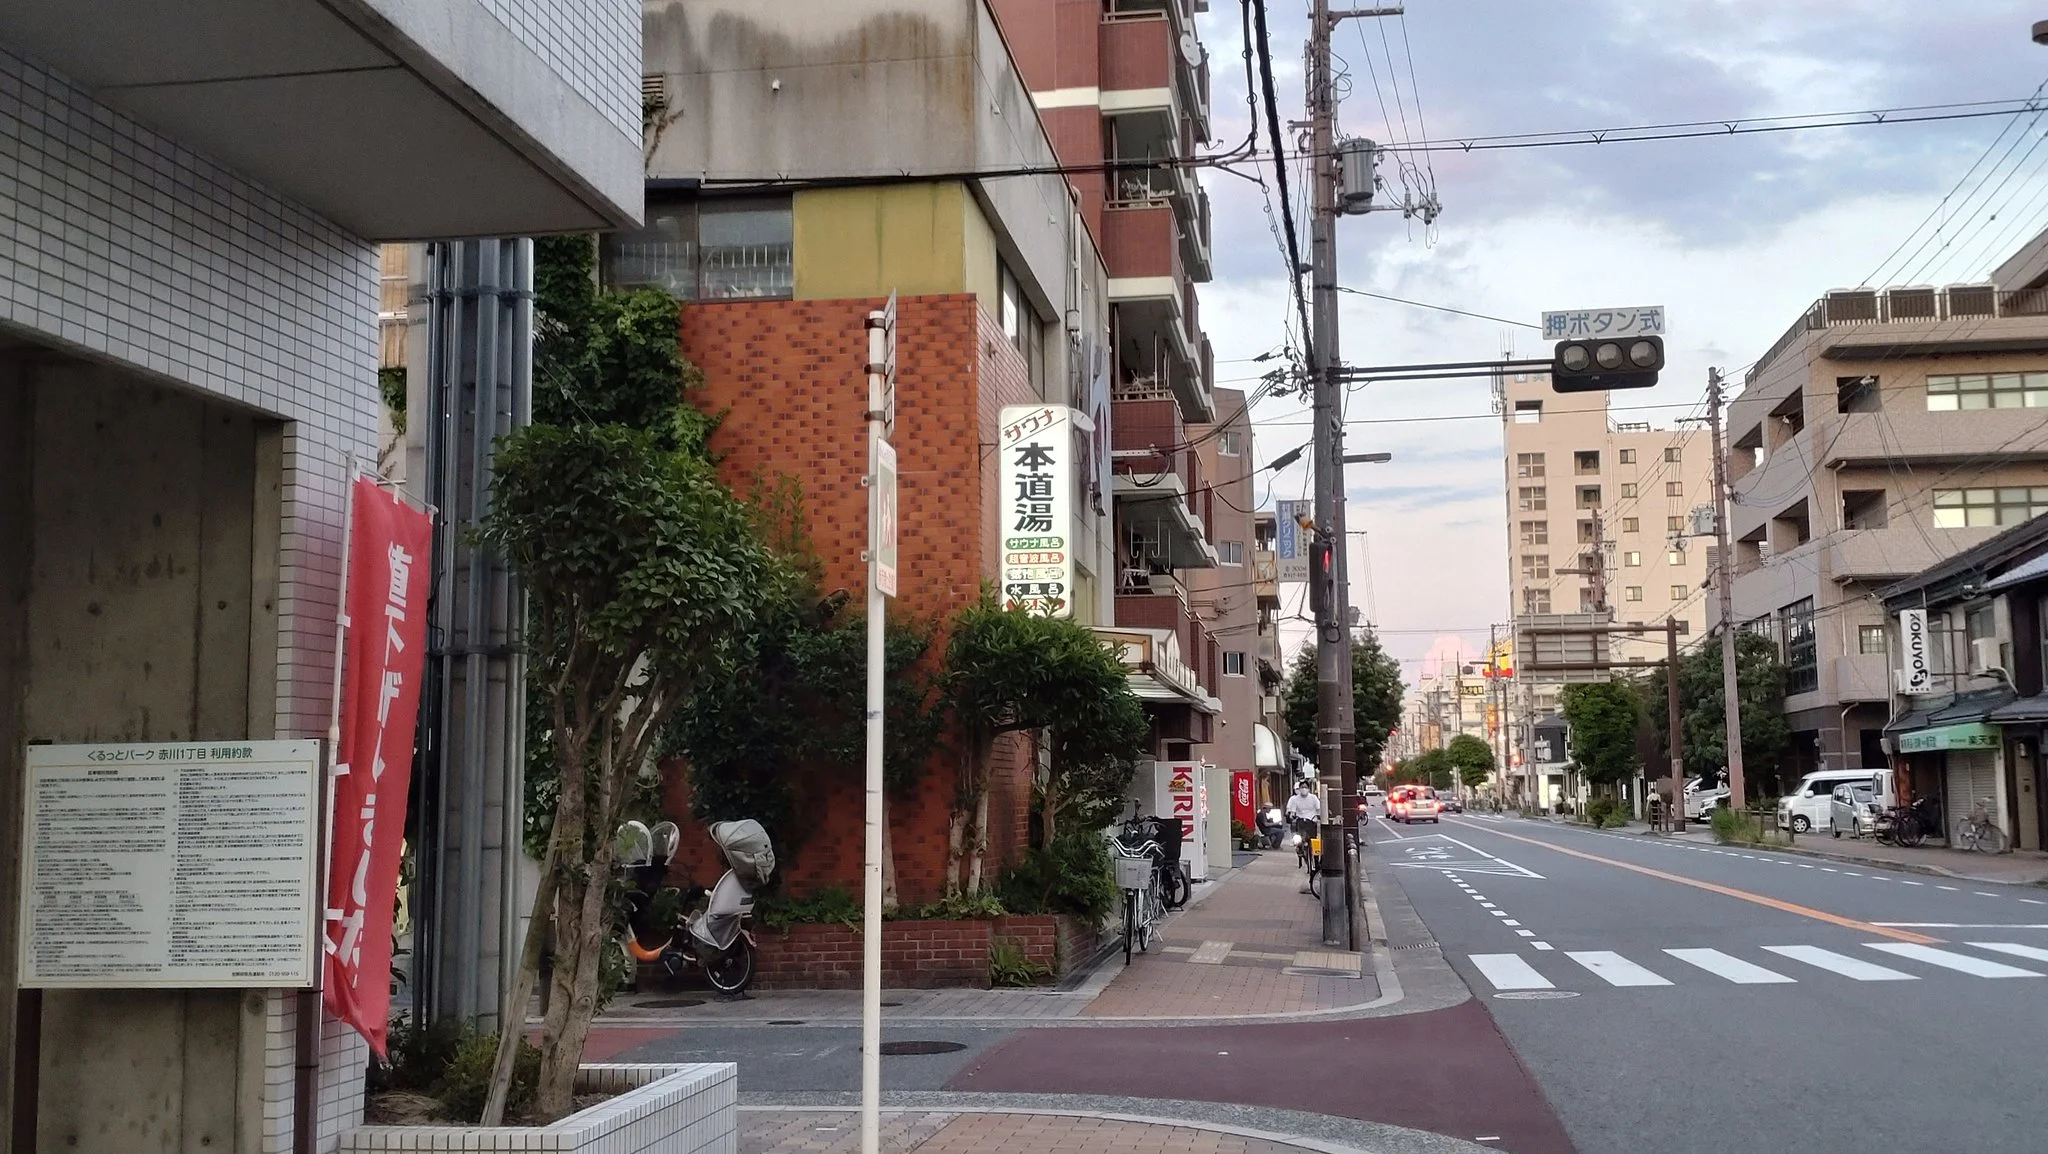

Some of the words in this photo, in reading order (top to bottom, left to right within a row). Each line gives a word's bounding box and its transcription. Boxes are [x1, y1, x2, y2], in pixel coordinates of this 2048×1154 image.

[1546, 309, 1661, 336] 押ボタン式
[1004, 409, 1054, 442] サウナ
[1014, 442, 1056, 532] 本道湯
[1009, 537, 1060, 549] サウナ風呂
[1010, 583, 1059, 595] 水風呂
[1910, 613, 1924, 669] KOKUYO
[87, 749, 155, 761] くるっとパーク
[158, 748, 206, 760] 赤川1丁目
[210, 747, 253, 759] 利用約款
